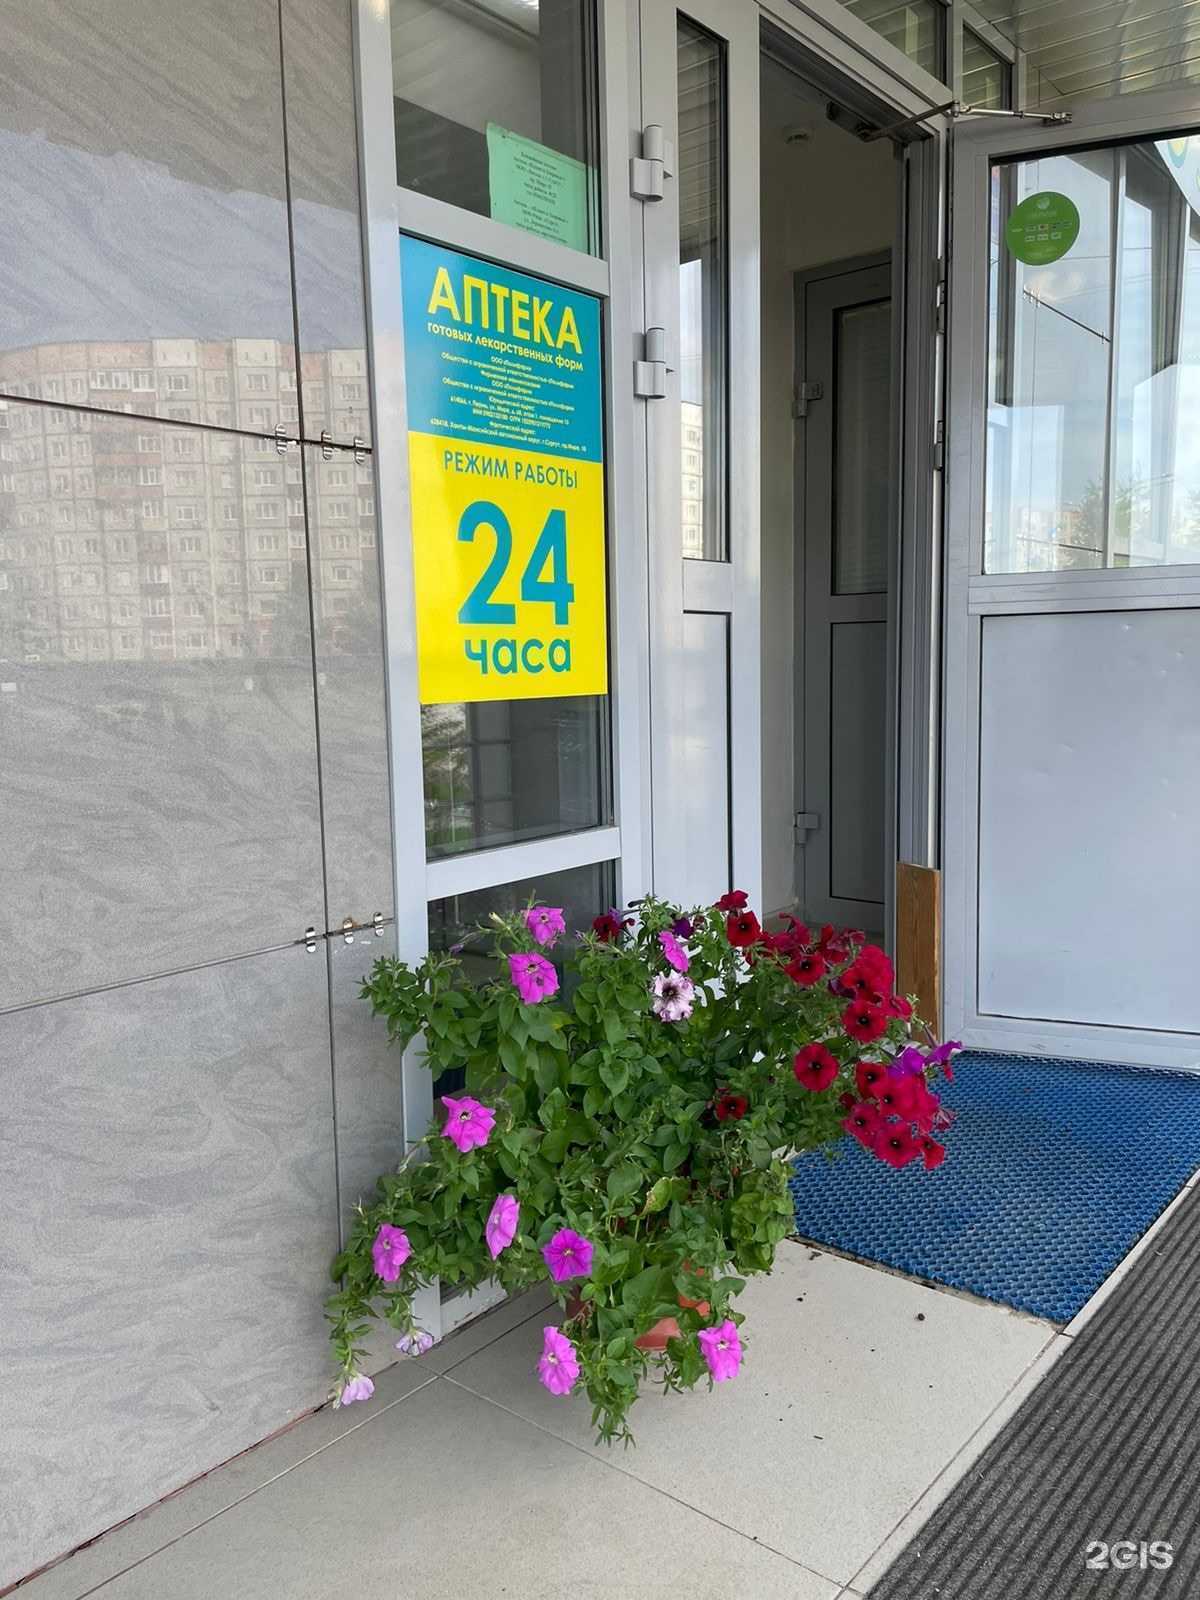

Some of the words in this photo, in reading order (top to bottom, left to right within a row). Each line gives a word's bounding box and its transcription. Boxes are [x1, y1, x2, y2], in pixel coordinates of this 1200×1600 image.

[427, 266, 583, 355] АПТЕКА
[427, 322, 473, 343] готовых
[475, 337, 554, 364] лекарственных
[555, 353, 584, 371] форм
[444, 450, 509, 480] РЕЖИМ
[514, 463, 578, 489] РАБОТЫ
[457, 499, 575, 625] 24
[465, 637, 571, 675] часа
